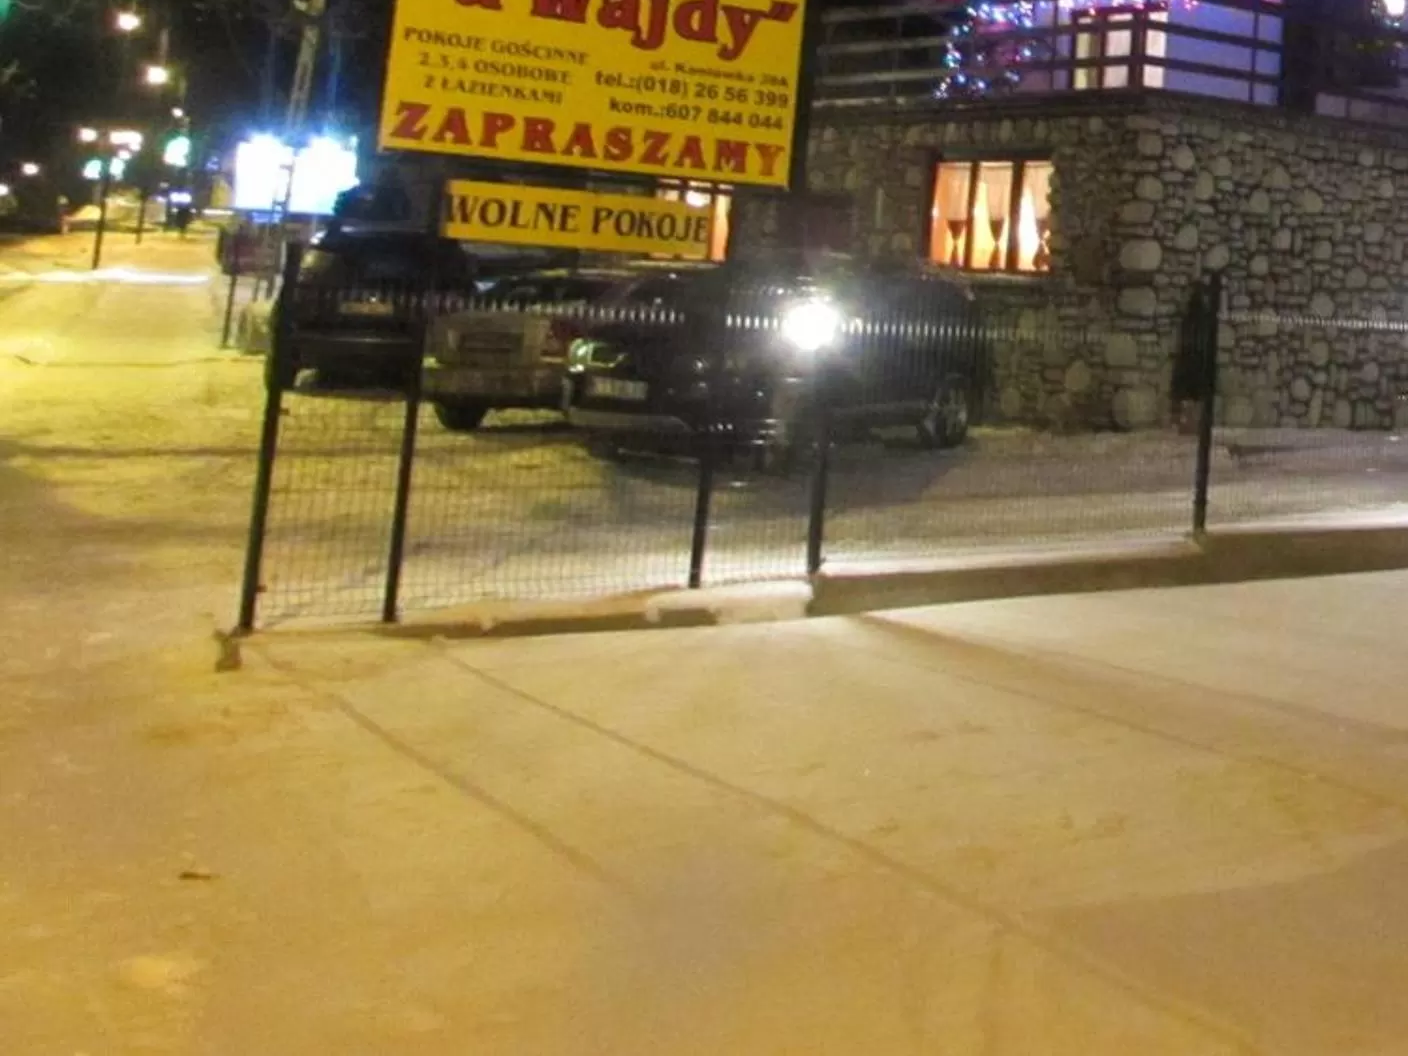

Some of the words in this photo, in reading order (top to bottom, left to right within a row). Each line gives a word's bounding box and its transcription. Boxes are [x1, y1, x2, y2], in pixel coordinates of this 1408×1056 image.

[404, 26, 485, 52] POKOJE
[490, 39, 589, 66] GOŚCINNE
[473, 59, 573, 85] OSOBOWE
[441, 76, 564, 106] ŁAZIENKAMI
[694, 81, 719, 100] 26
[723, 86, 748, 104] 56
[753, 88, 790, 108] 399
[707, 108, 743, 125] 844
[748, 112, 783, 130] 044
[390, 101, 787, 177] ZAPRASZAMY
[447, 193, 580, 233] WOLNE
[591, 206, 710, 243] POKOJE
